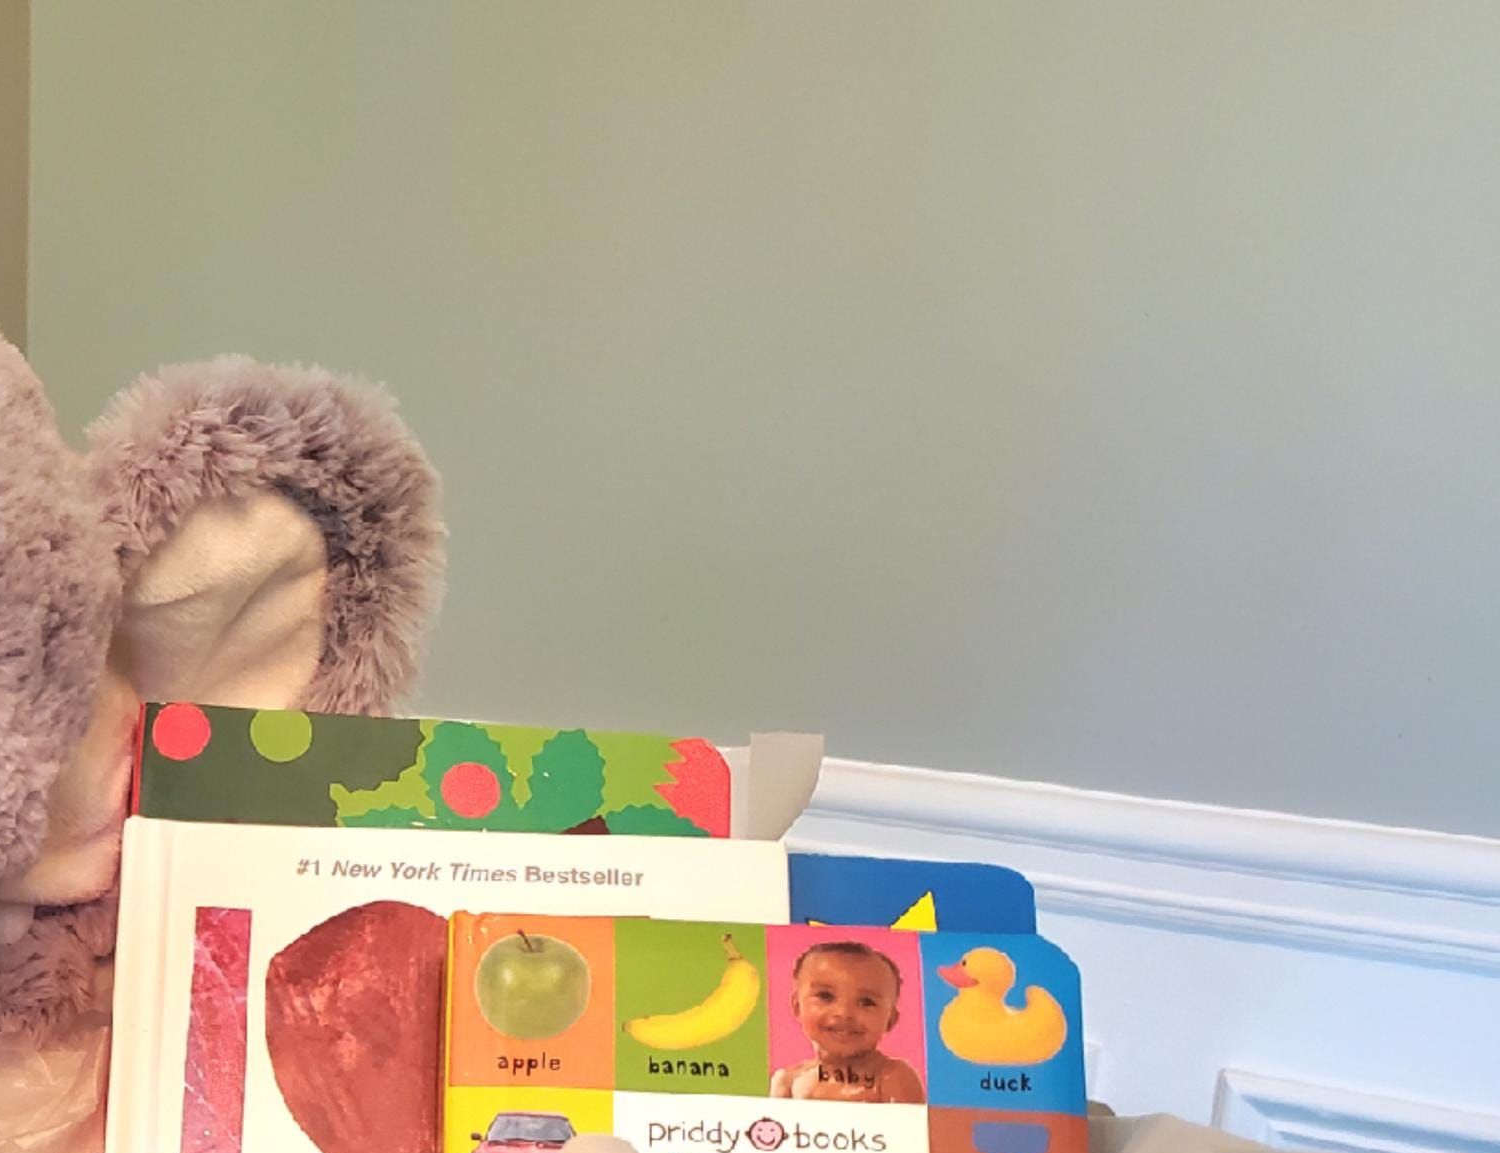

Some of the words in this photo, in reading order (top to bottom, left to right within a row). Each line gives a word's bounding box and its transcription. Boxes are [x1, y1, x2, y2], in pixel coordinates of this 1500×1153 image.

[297, 859, 320, 875] #1
[331, 860, 382, 879] New
[391, 861, 441, 881] York
[451, 863, 517, 883] Times
[524, 865, 644, 886] Bestseller
[498, 1052, 561, 1076] apple
[649, 1056, 730, 1078] banana
[818, 1064, 875, 1089] baby
[980, 1072, 1032, 1092] duck
[649, 1121, 740, 1153] priddy
[796, 1122, 887, 1152] books
